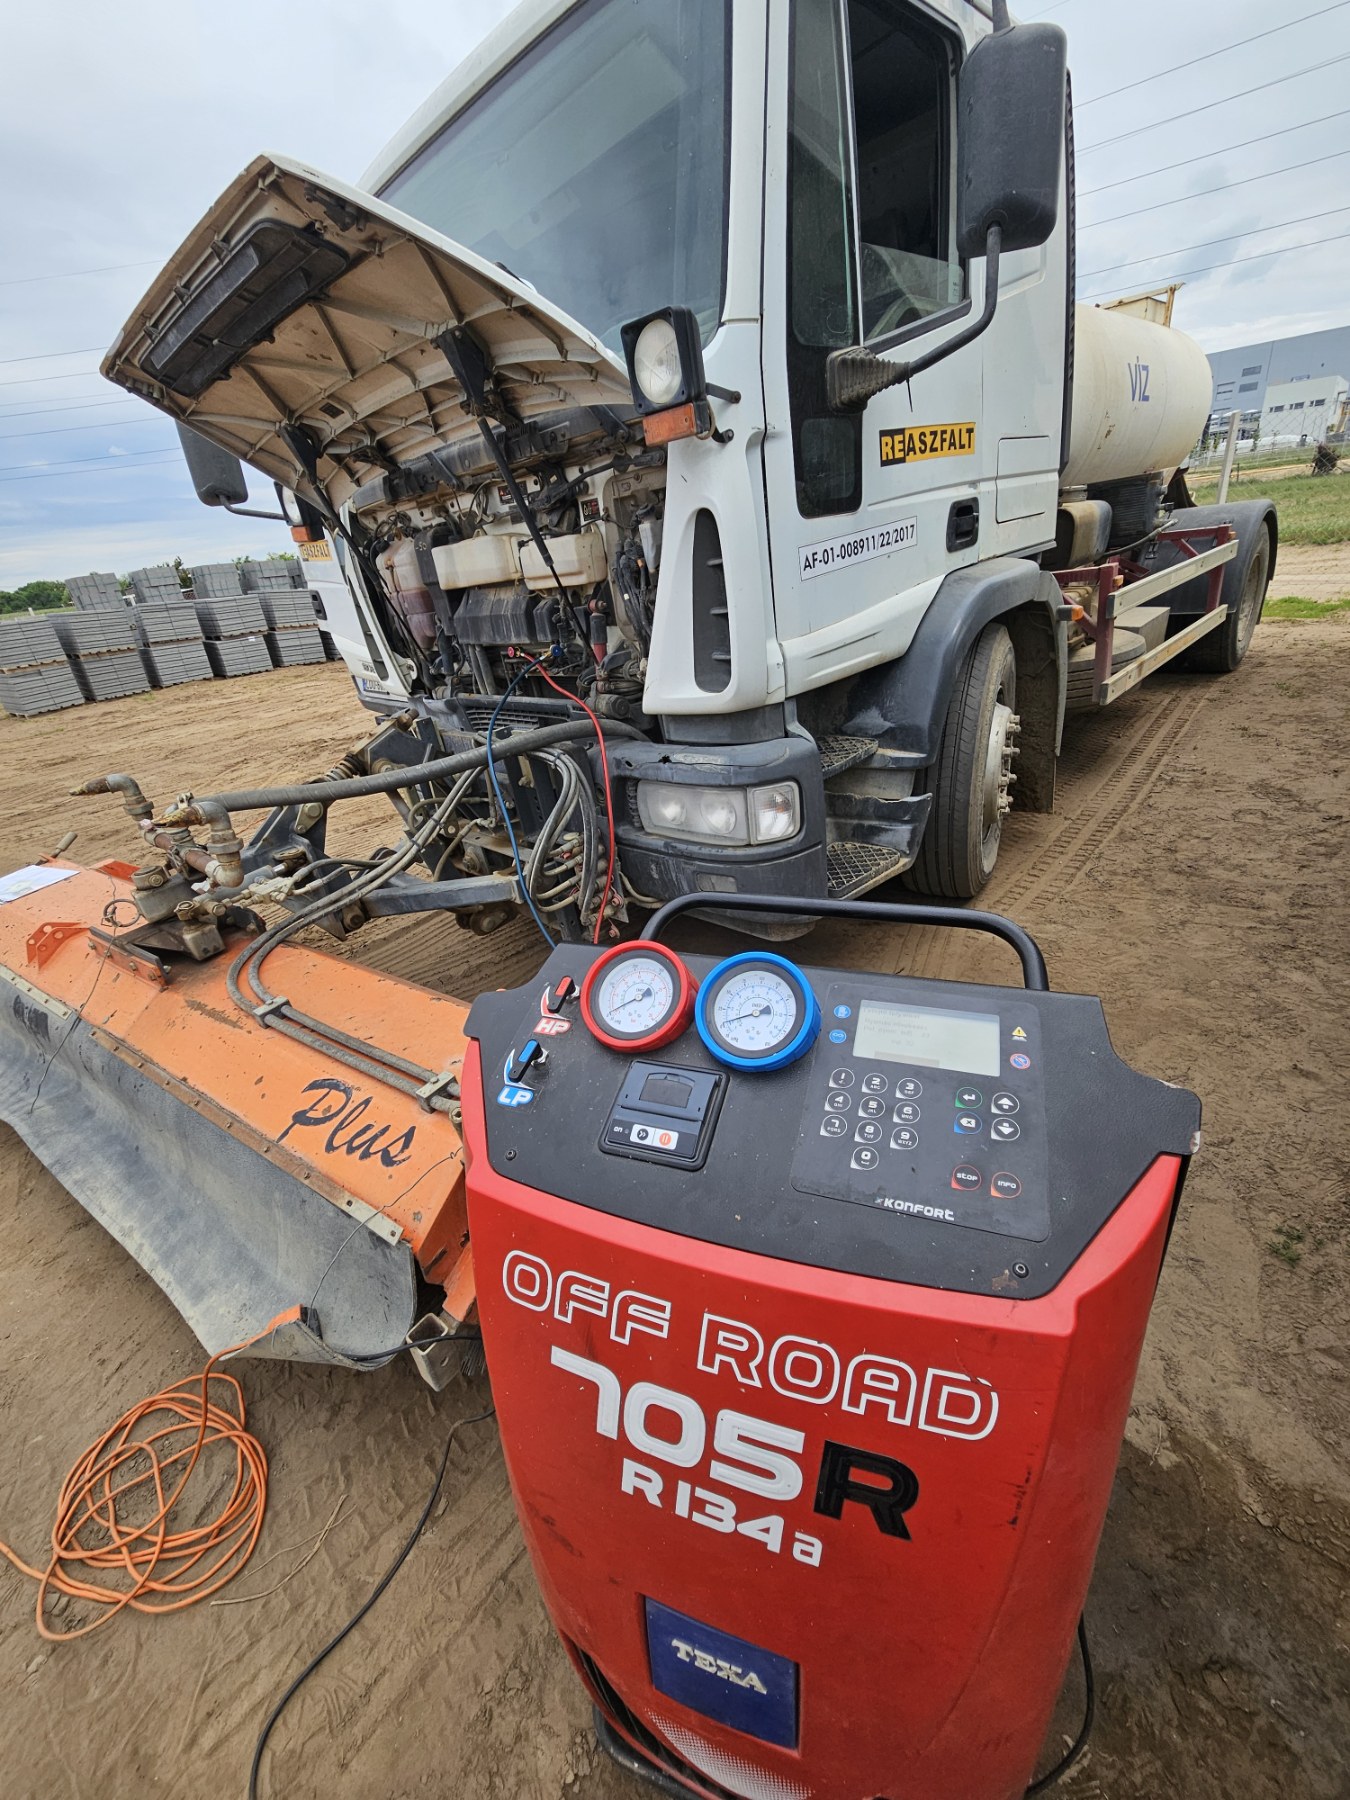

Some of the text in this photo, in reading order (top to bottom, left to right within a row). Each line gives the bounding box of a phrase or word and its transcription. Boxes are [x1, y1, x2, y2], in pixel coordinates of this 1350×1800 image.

[881, 428, 975, 461] REASZFALT
[803, 524, 916, 572] AF-01-008911/22/2017
[536, 1018, 570, 1036] HP
[871, 1077, 881, 1085] 2
[905, 1082, 915, 1090] 3
[499, 1087, 533, 1105] LP
[834, 1095, 844, 1103] 4
[868, 1100, 878, 1109] 5
[903, 1106, 913, 1114] 6
[276, 1078, 416, 1168] Plus
[831, 1119, 840, 1128] 7
[865, 1125, 875, 1133] 8
[900, 1131, 910, 1140] 9
[502, 1250, 999, 1441] OFF ROAD
[671, 1638, 768, 1695] TEXA
